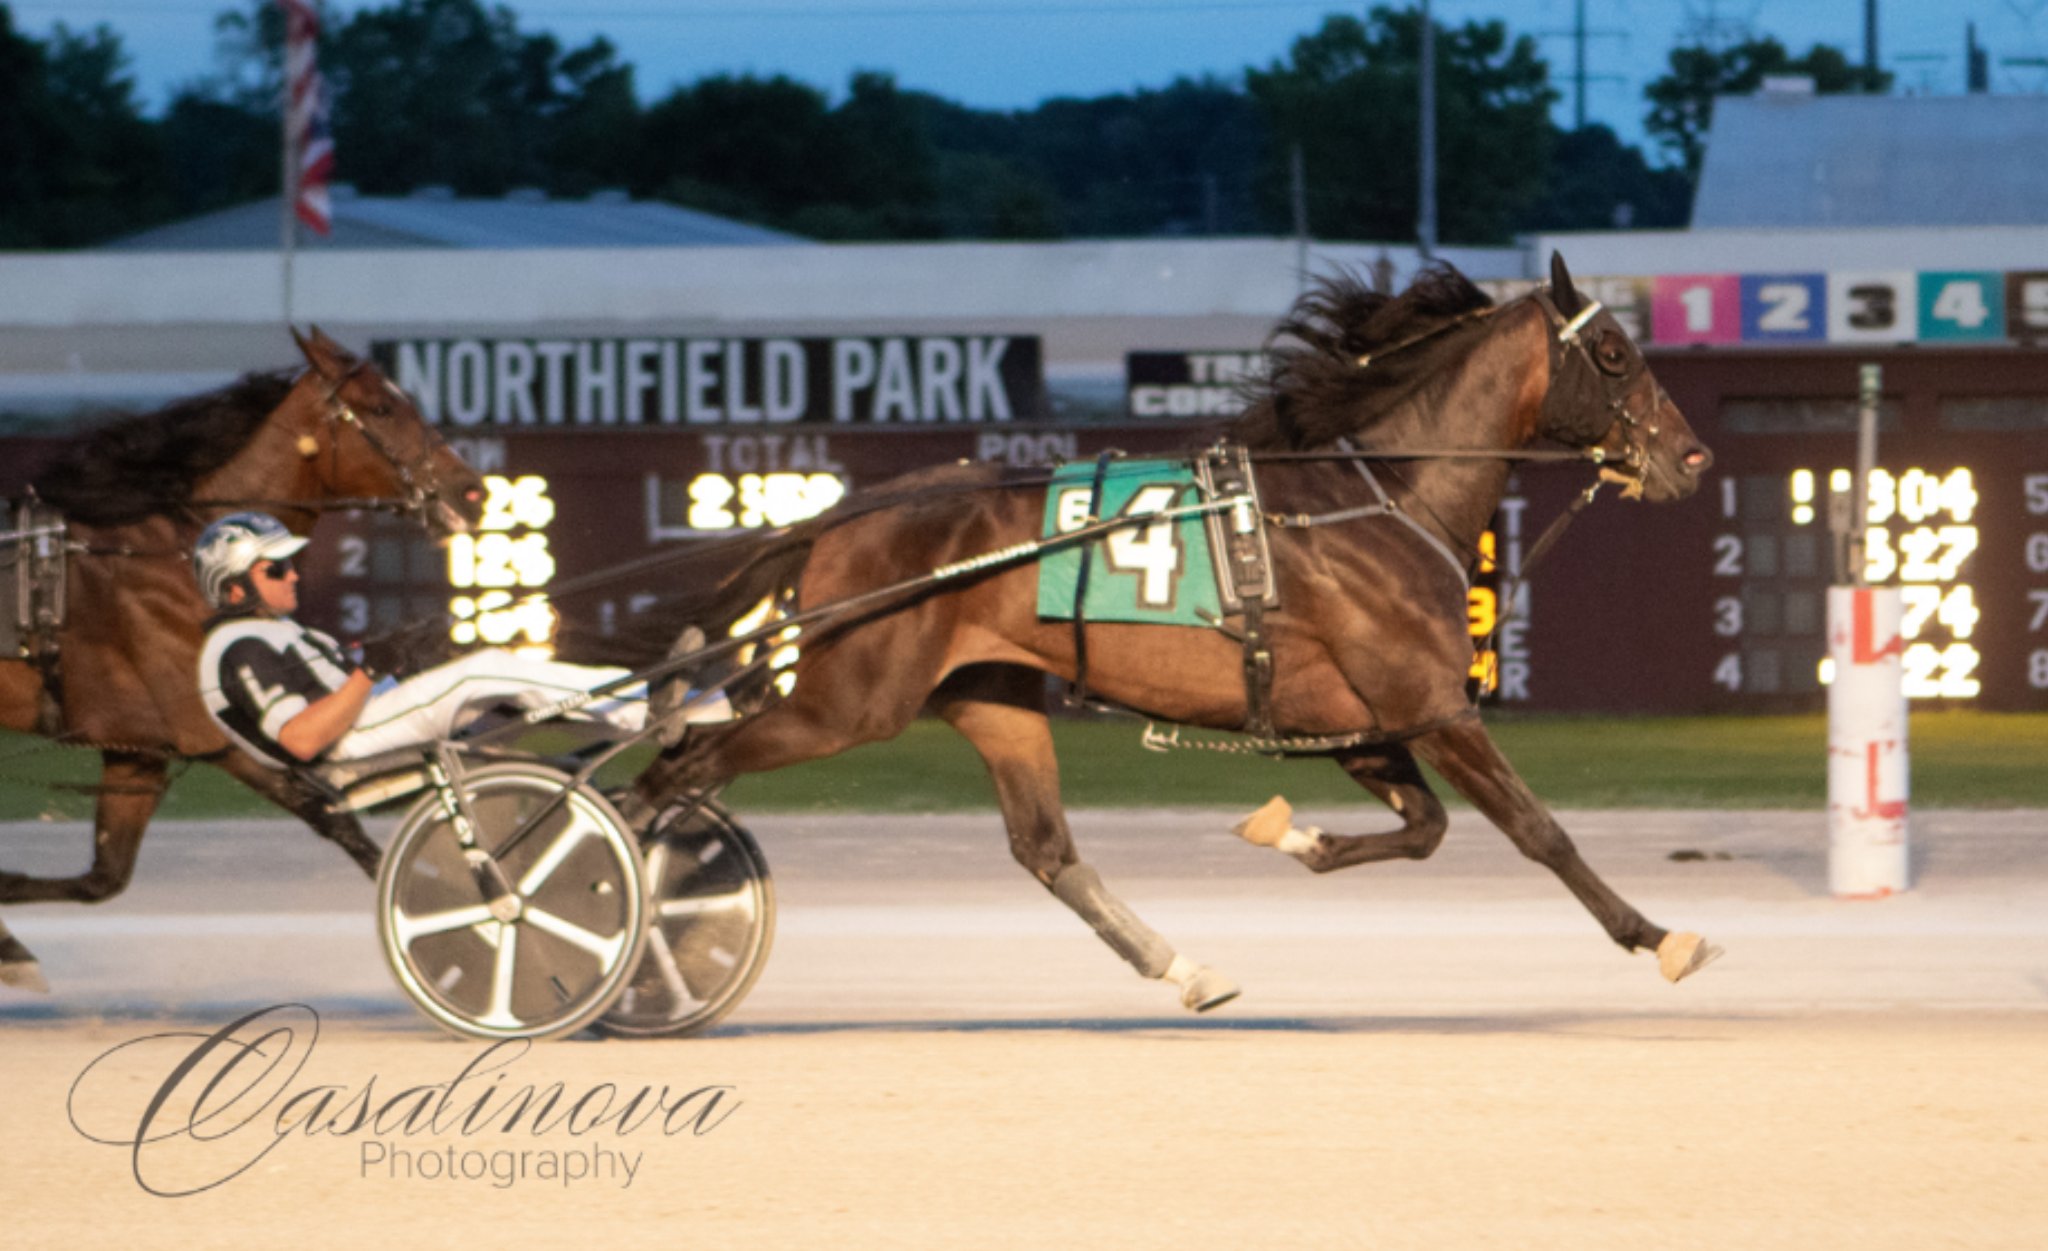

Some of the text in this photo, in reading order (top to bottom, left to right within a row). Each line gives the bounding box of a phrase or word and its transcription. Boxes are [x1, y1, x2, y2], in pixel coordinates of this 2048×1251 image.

[1681, 286, 1714, 332] 1
[1757, 284, 1811, 331] 2
[1846, 284, 1896, 329] 3
[1933, 281, 1988, 327] 4
[401, 338, 1014, 424] NORTHFIELD PARK
[703, 435, 844, 472] TOTAL
[1721, 480, 1736, 518] 1
[339, 536, 367, 576] 2
[1105, 484, 1182, 608] 4
[1713, 534, 1743, 576] 2
[341, 595, 368, 632] 3
[1714, 597, 1743, 636] 3
[1714, 653, 1743, 691] 4
